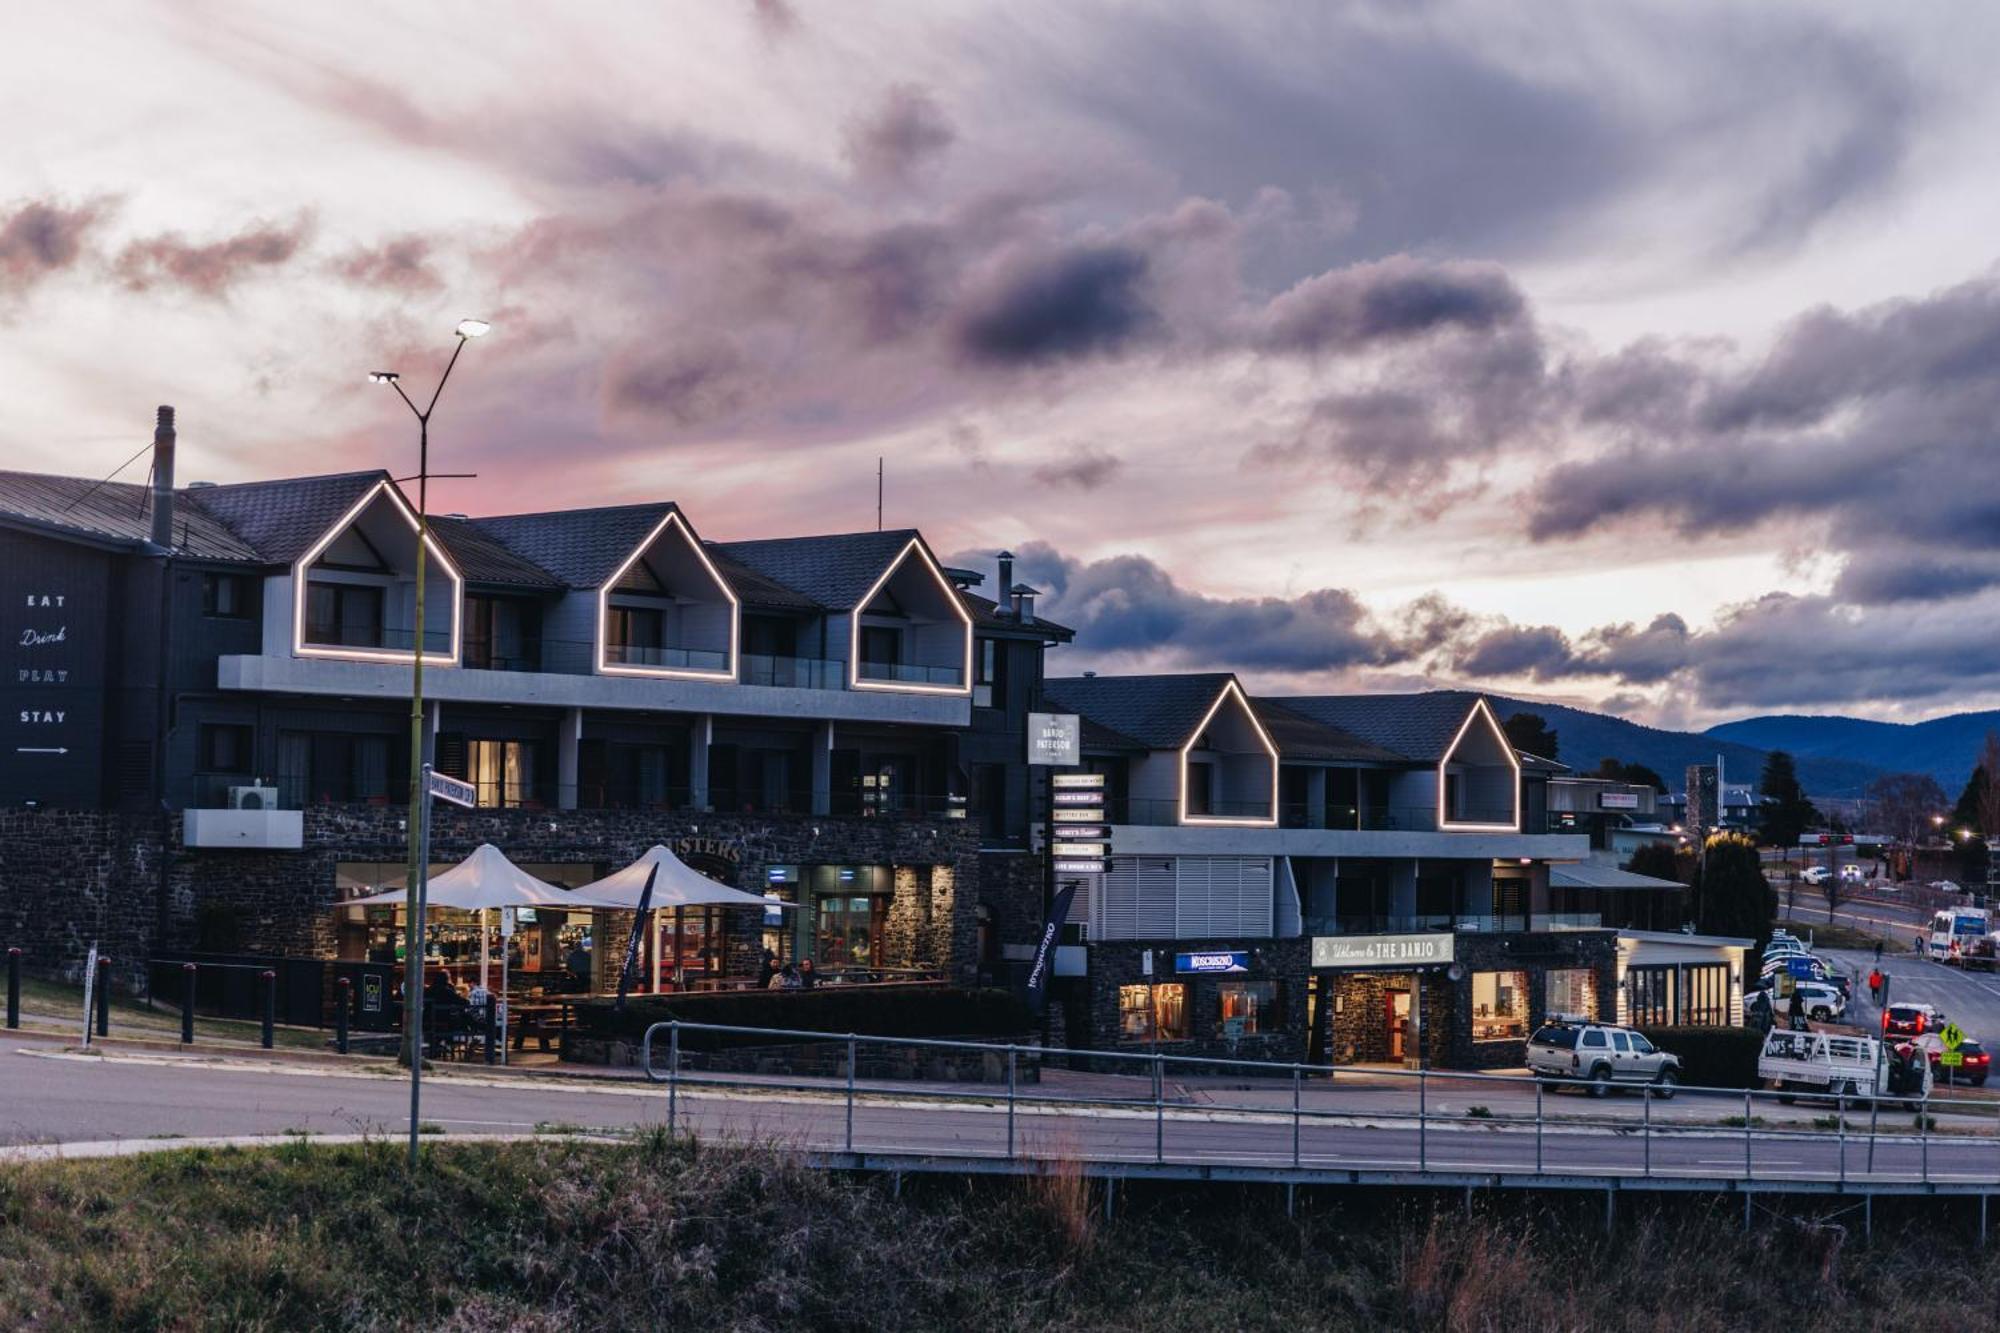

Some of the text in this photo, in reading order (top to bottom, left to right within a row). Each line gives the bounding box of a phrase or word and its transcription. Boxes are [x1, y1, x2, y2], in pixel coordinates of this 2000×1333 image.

[27, 595, 65, 607] EAT
[19, 626, 66, 646] Drink
[19, 669, 68, 682] PLAY
[20, 711, 65, 723] STAY
[1376, 943, 1396, 958] THE
[1401, 942, 1433, 958] BANJO
